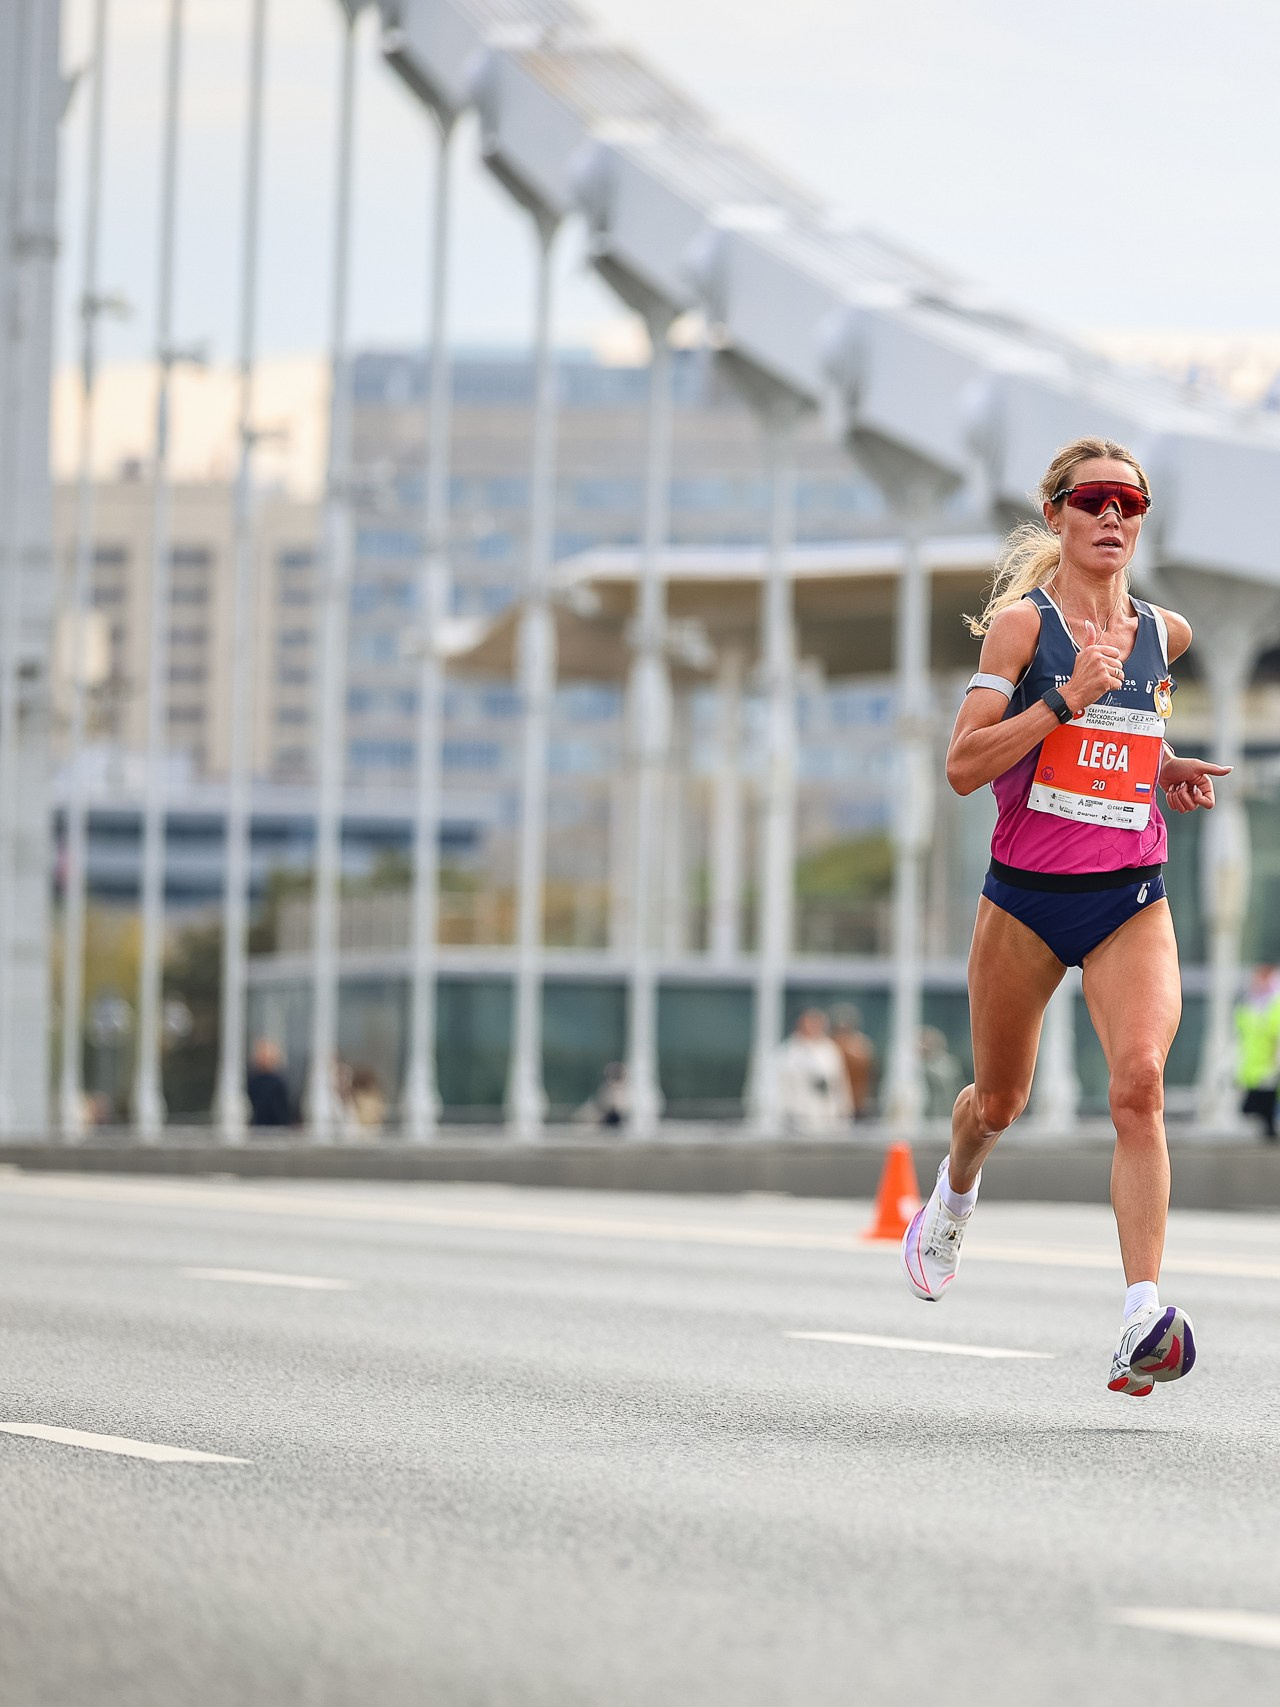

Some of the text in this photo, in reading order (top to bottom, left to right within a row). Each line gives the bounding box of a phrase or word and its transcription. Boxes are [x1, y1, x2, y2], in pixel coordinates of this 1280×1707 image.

[1085, 718, 1115, 727] МАРАФОН
[1086, 713, 1126, 723] МОСКОВСКИЙ
[1077, 739, 1129, 773] LEGA
[1091, 779, 1106, 791] 20
